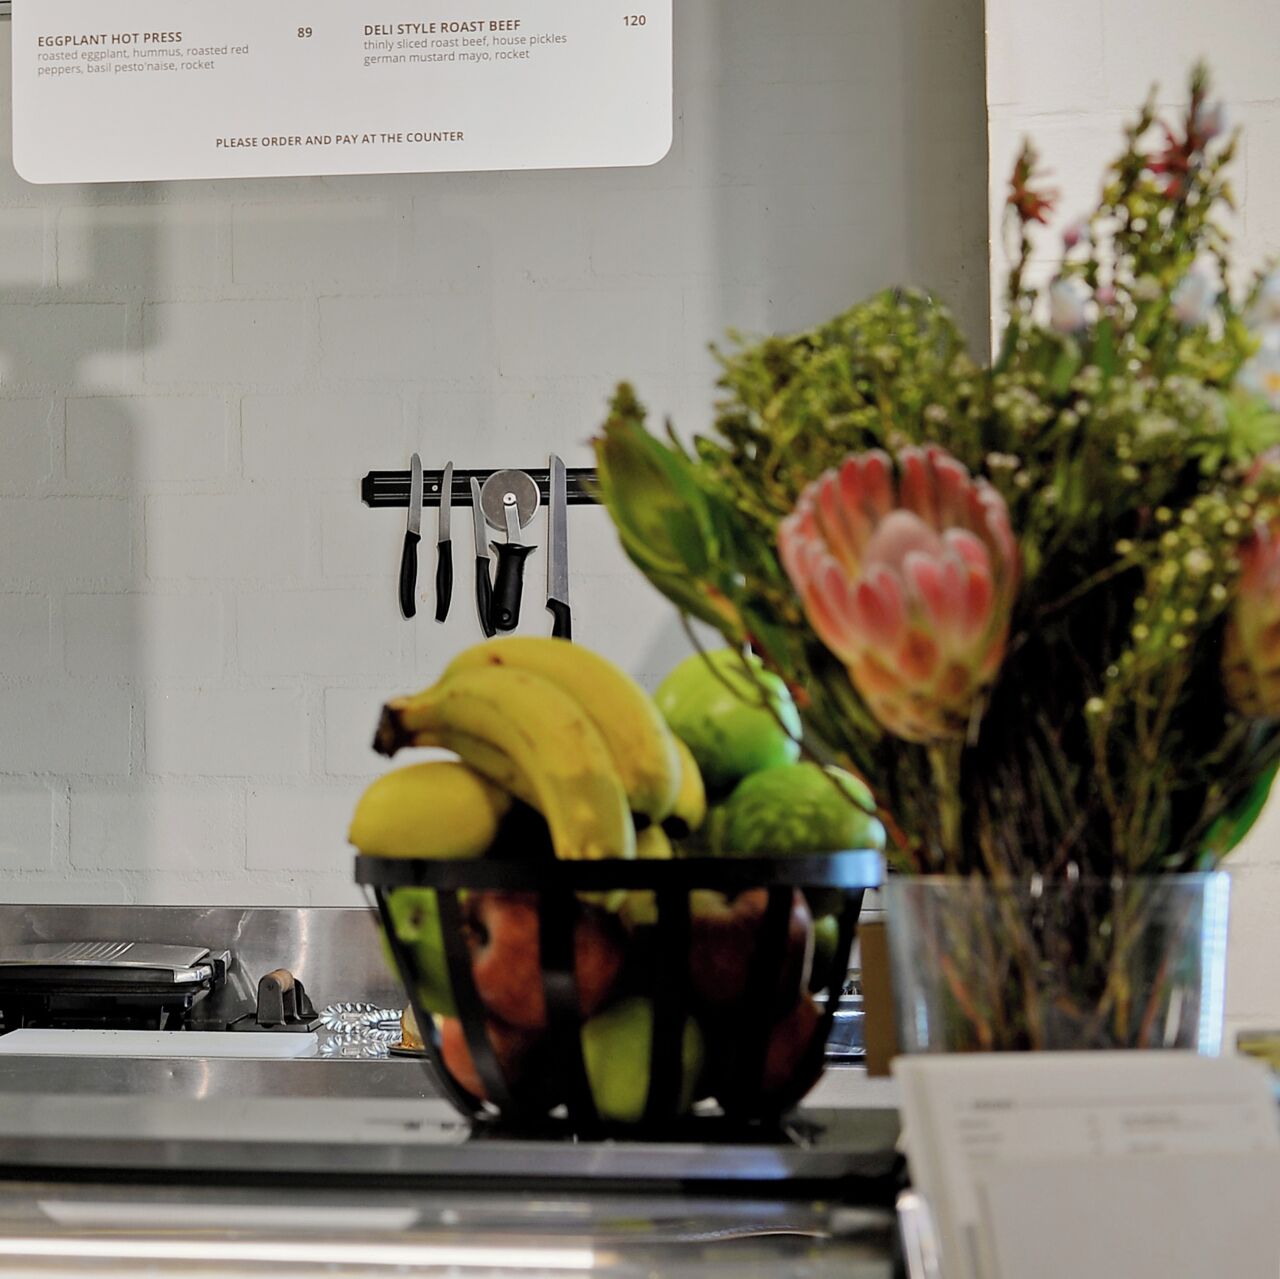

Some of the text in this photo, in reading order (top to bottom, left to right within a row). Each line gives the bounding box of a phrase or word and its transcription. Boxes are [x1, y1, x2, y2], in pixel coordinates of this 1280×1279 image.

[364, 19, 520, 36] DELI STYLE ROAST BEEF
[623, 14, 646, 26] 120
[38, 32, 182, 47] EGGPLANT HOT PRESS
[297, 27, 312, 38] 89
[216, 131, 464, 148] PLEASE ORDER AND PAY AT THE COUNTER
